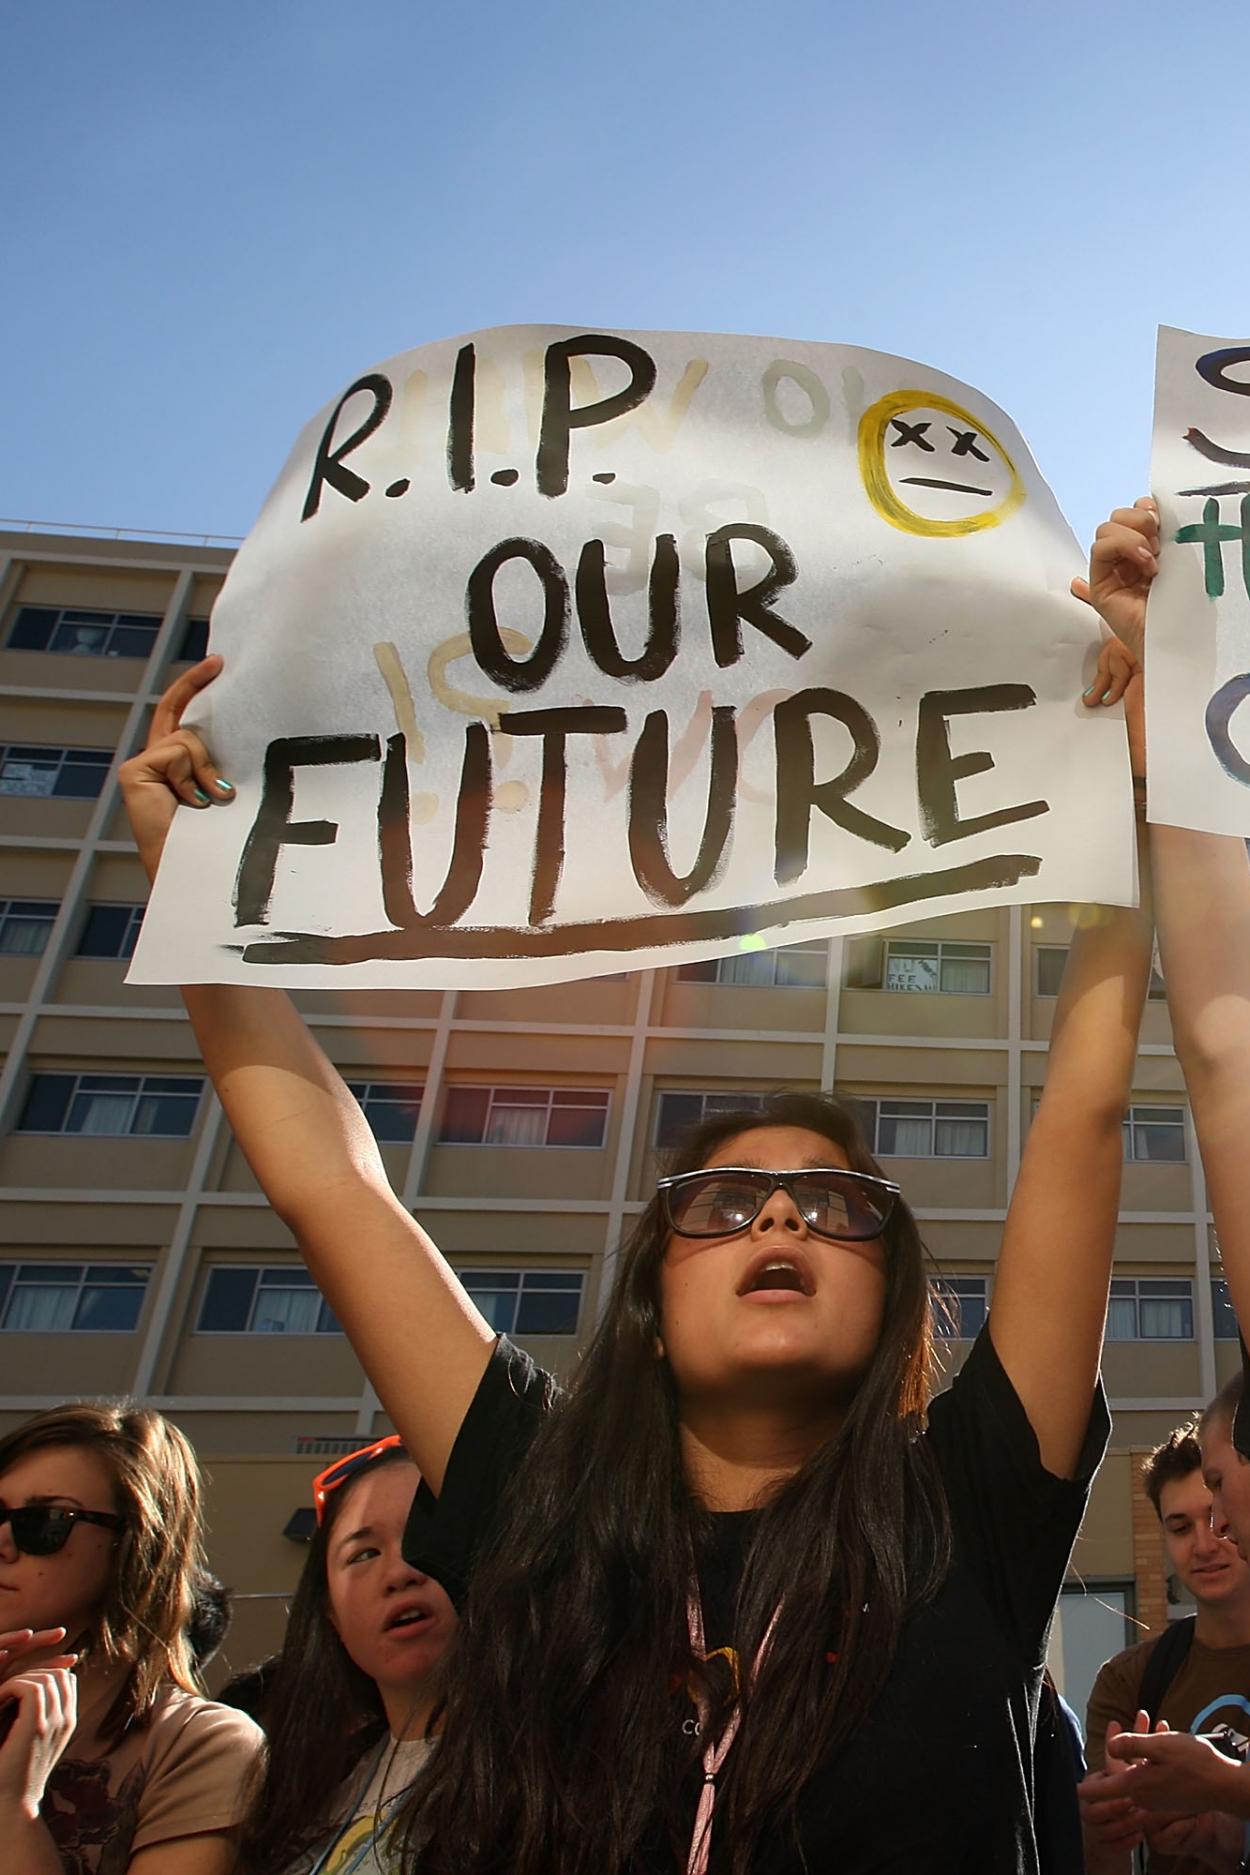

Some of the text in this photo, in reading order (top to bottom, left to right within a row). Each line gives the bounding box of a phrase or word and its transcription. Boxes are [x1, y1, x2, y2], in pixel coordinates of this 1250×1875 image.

[301, 334, 657, 522] R.I.P.
[465, 522, 812, 694] OUR
[233, 683, 1050, 928] FUTURE
